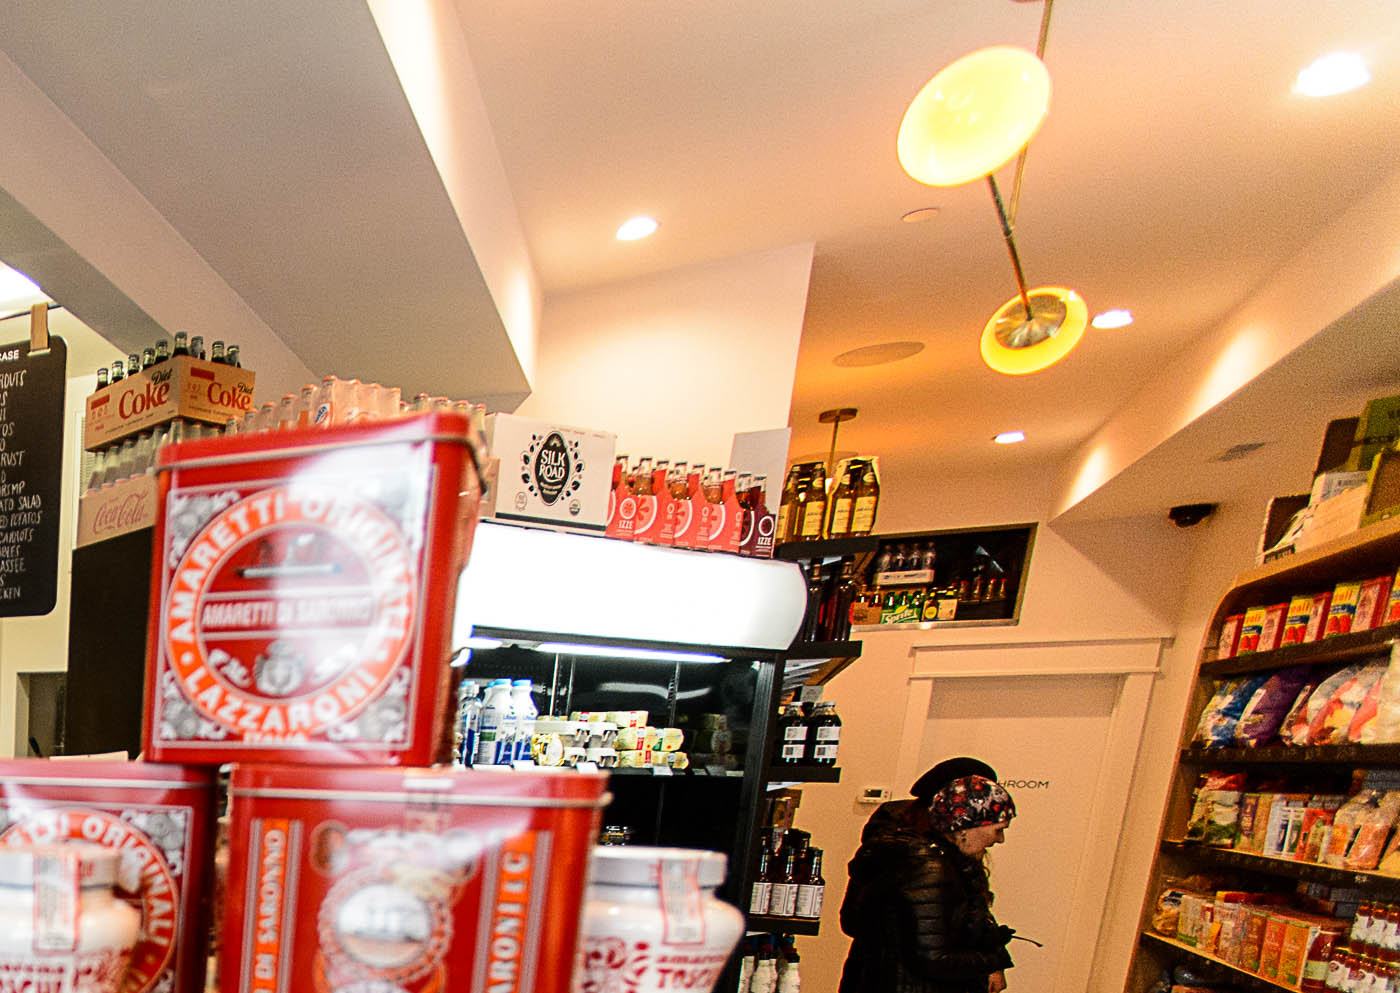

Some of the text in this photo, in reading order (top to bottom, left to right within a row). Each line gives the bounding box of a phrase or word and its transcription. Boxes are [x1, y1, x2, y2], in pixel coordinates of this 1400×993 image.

[152, 368, 174, 386] Diet
[119, 382, 170, 420] Coke
[207, 382, 252, 411] Coke
[540, 449, 566, 467] SILK
[539, 464, 566, 479] ROAD
[18, 495, 41, 510] SALAD
[10, 511, 42, 527] POTATOS
[618, 519, 633, 530] IZZE
[757, 536, 772, 546] IZZE
[170, 494, 286, 644] AMARETTI
[185, 666, 378, 734] LAZZARONI
[257, 829, 287, 944] SARONNO
[256, 953, 276, 980] DI
